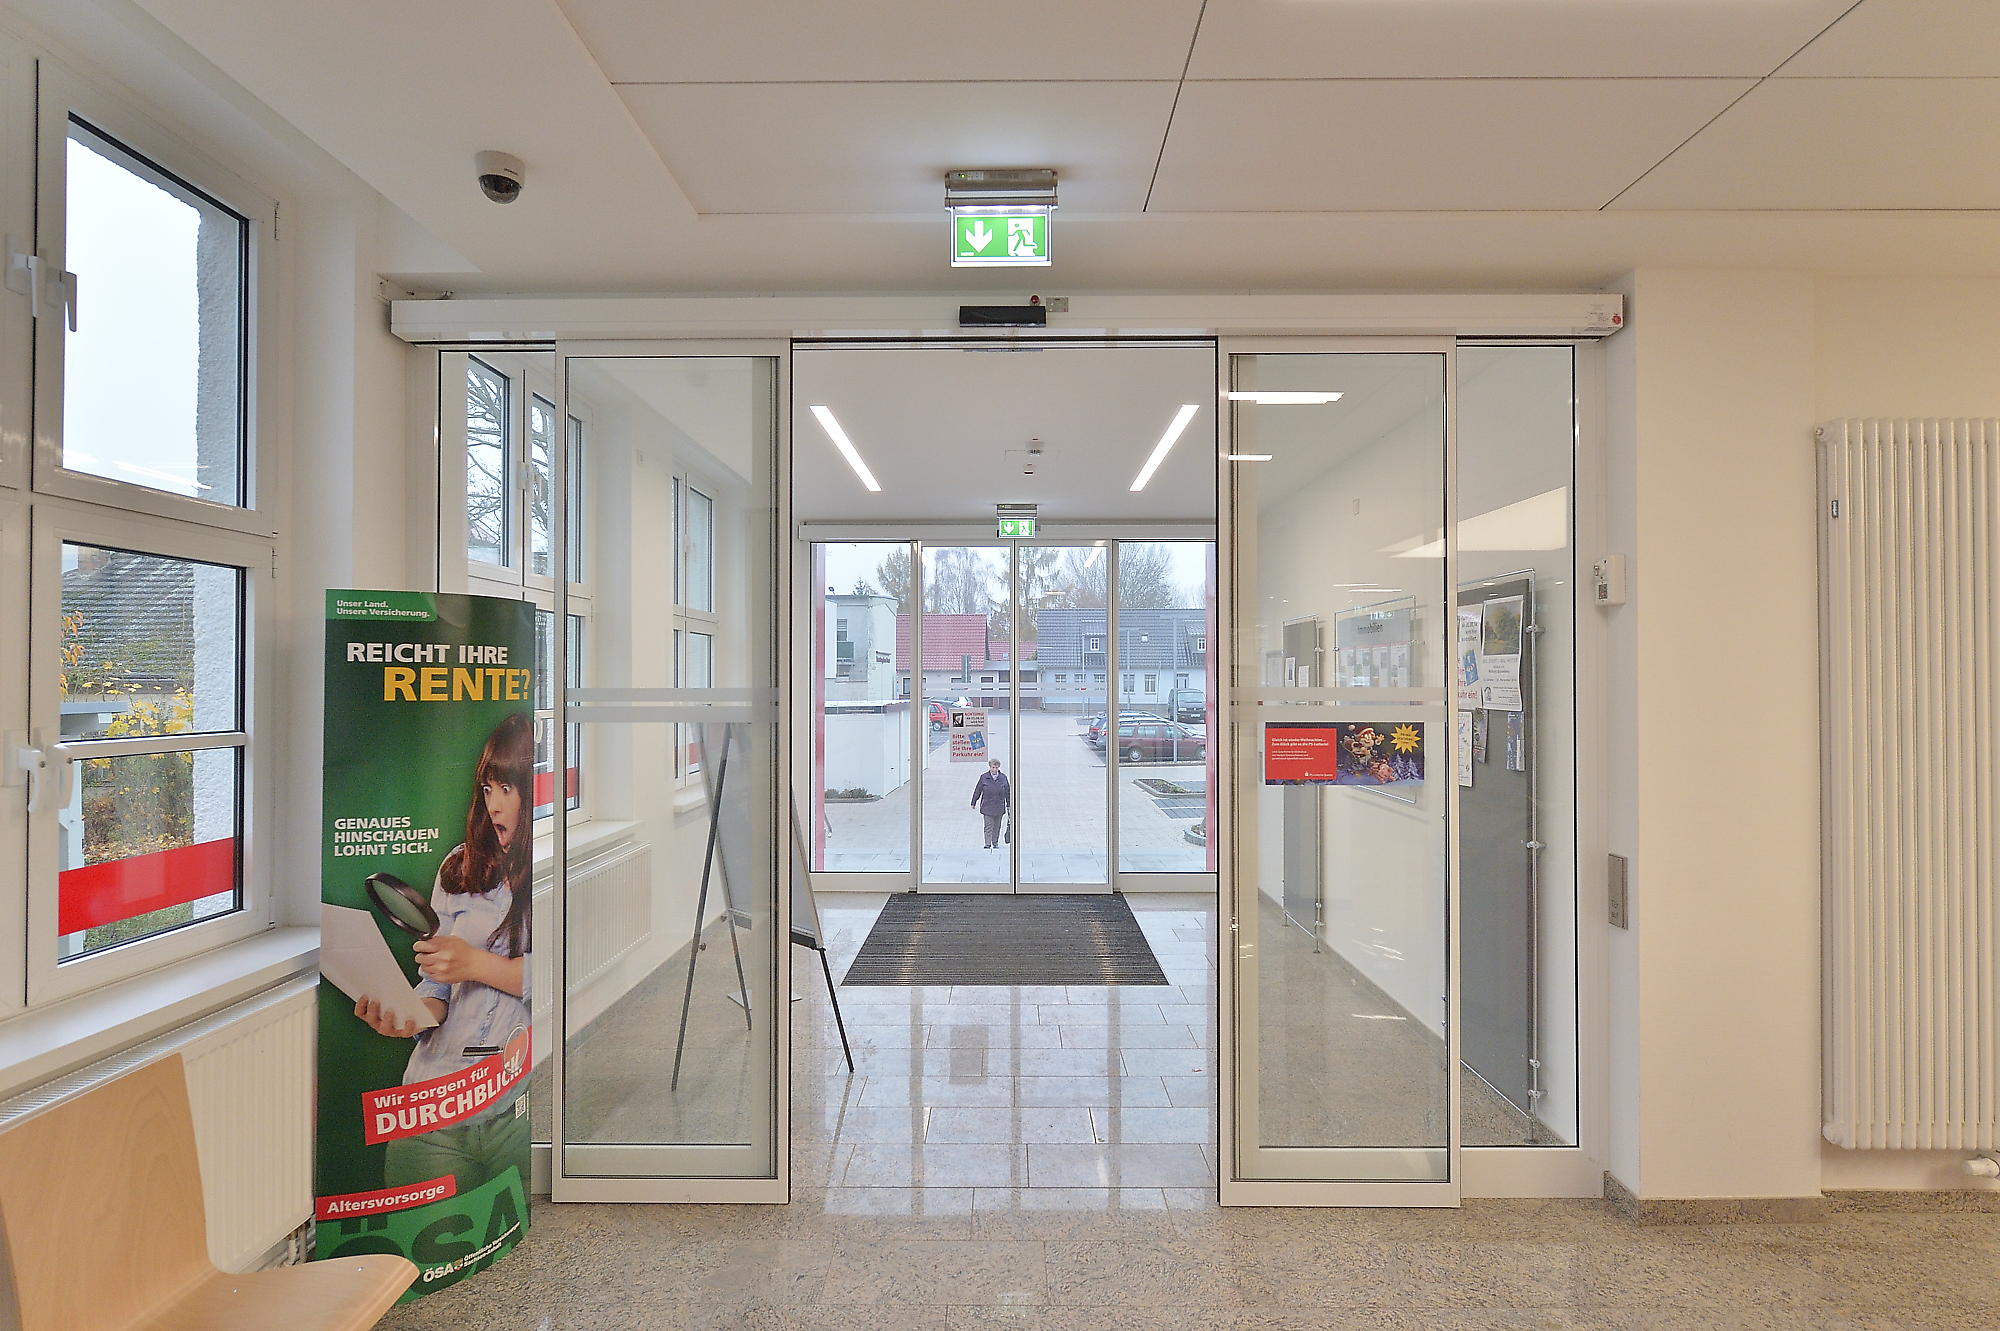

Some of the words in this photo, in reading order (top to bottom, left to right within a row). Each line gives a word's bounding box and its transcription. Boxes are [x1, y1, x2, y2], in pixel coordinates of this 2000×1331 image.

[336, 600, 363, 609] Unser
[364, 601, 389, 609] Land.
[336, 608, 367, 616] Unsere
[369, 609, 430, 619] Versicherung.
[347, 642, 450, 664] REICHT
[459, 645, 508, 665] IHRE
[384, 666, 531, 702] RENTE?
[334, 816, 411, 830] GENAUES
[334, 828, 439, 843] HINSCHAUEN
[334, 844, 387, 857] LOHNT
[391, 842, 433, 855] SICH.
[374, 1093, 403, 1109] Wir
[409, 1079, 467, 1102] sorgen
[470, 1065, 490, 1084] für
[327, 1184, 446, 1214] Altersvorsorge
[423, 1262, 455, 1283] ÖSA
